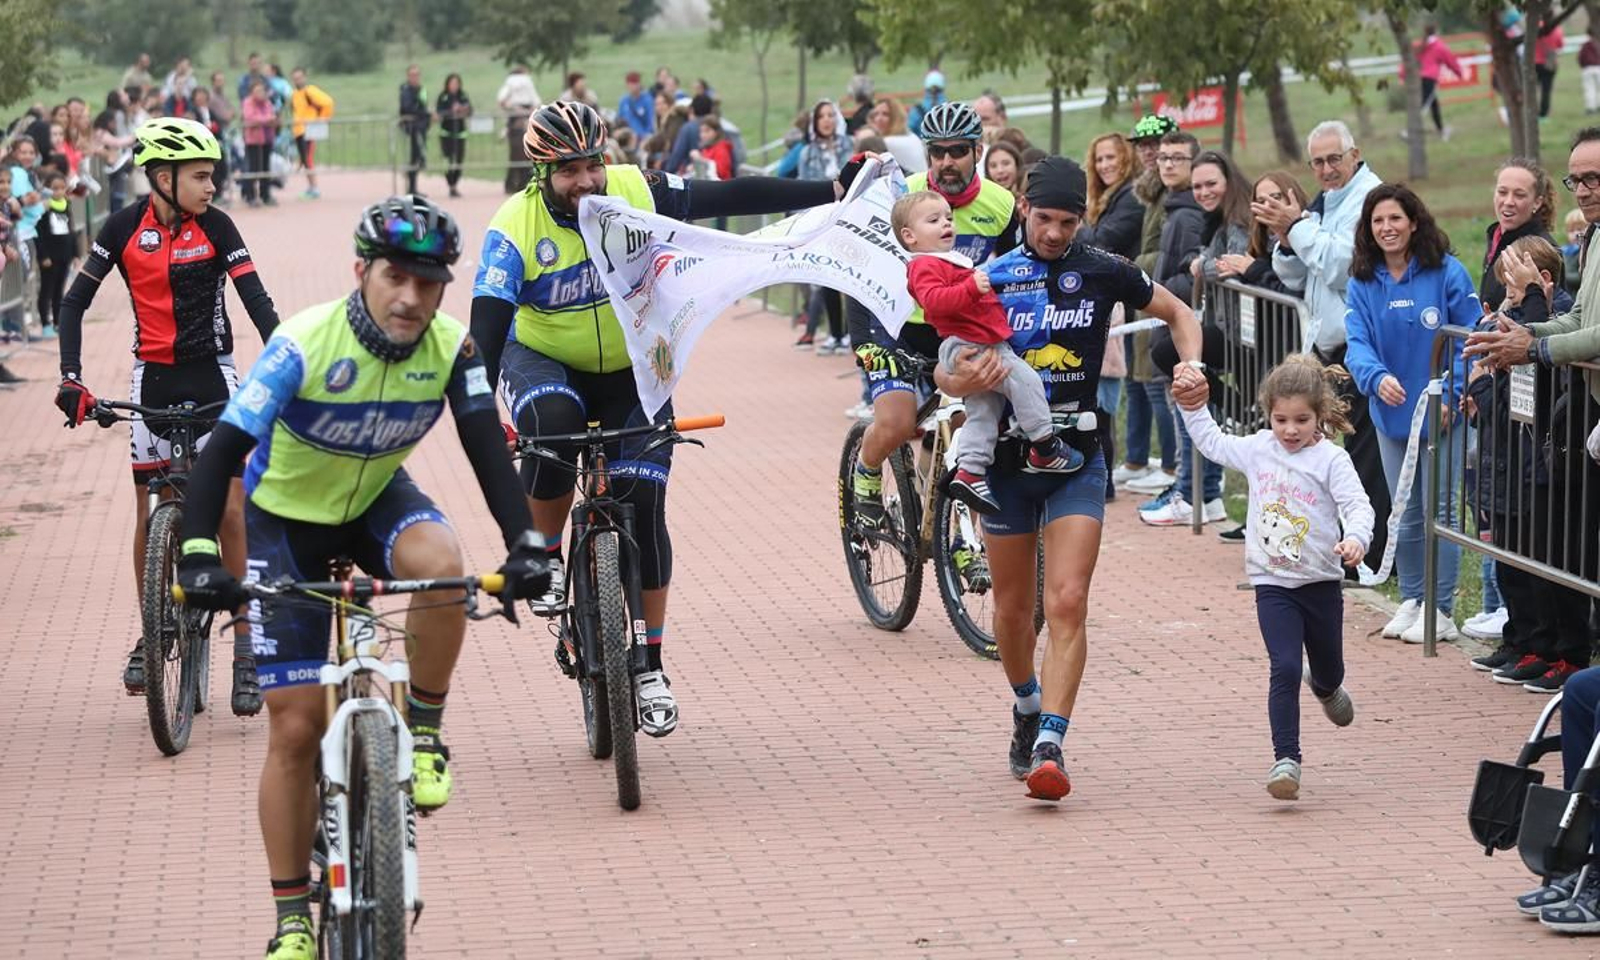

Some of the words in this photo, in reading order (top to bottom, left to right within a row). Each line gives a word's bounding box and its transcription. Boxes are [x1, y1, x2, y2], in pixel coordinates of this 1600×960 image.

[801, 252, 897, 312] ROSALEDA
[1007, 307, 1036, 331] LOS
[1040, 304, 1095, 331] PUPAS
[541, 385, 555, 393] IN
[307, 409, 358, 443] LOS
[352, 407, 434, 449] PUPAS
[639, 467, 651, 476] IN
